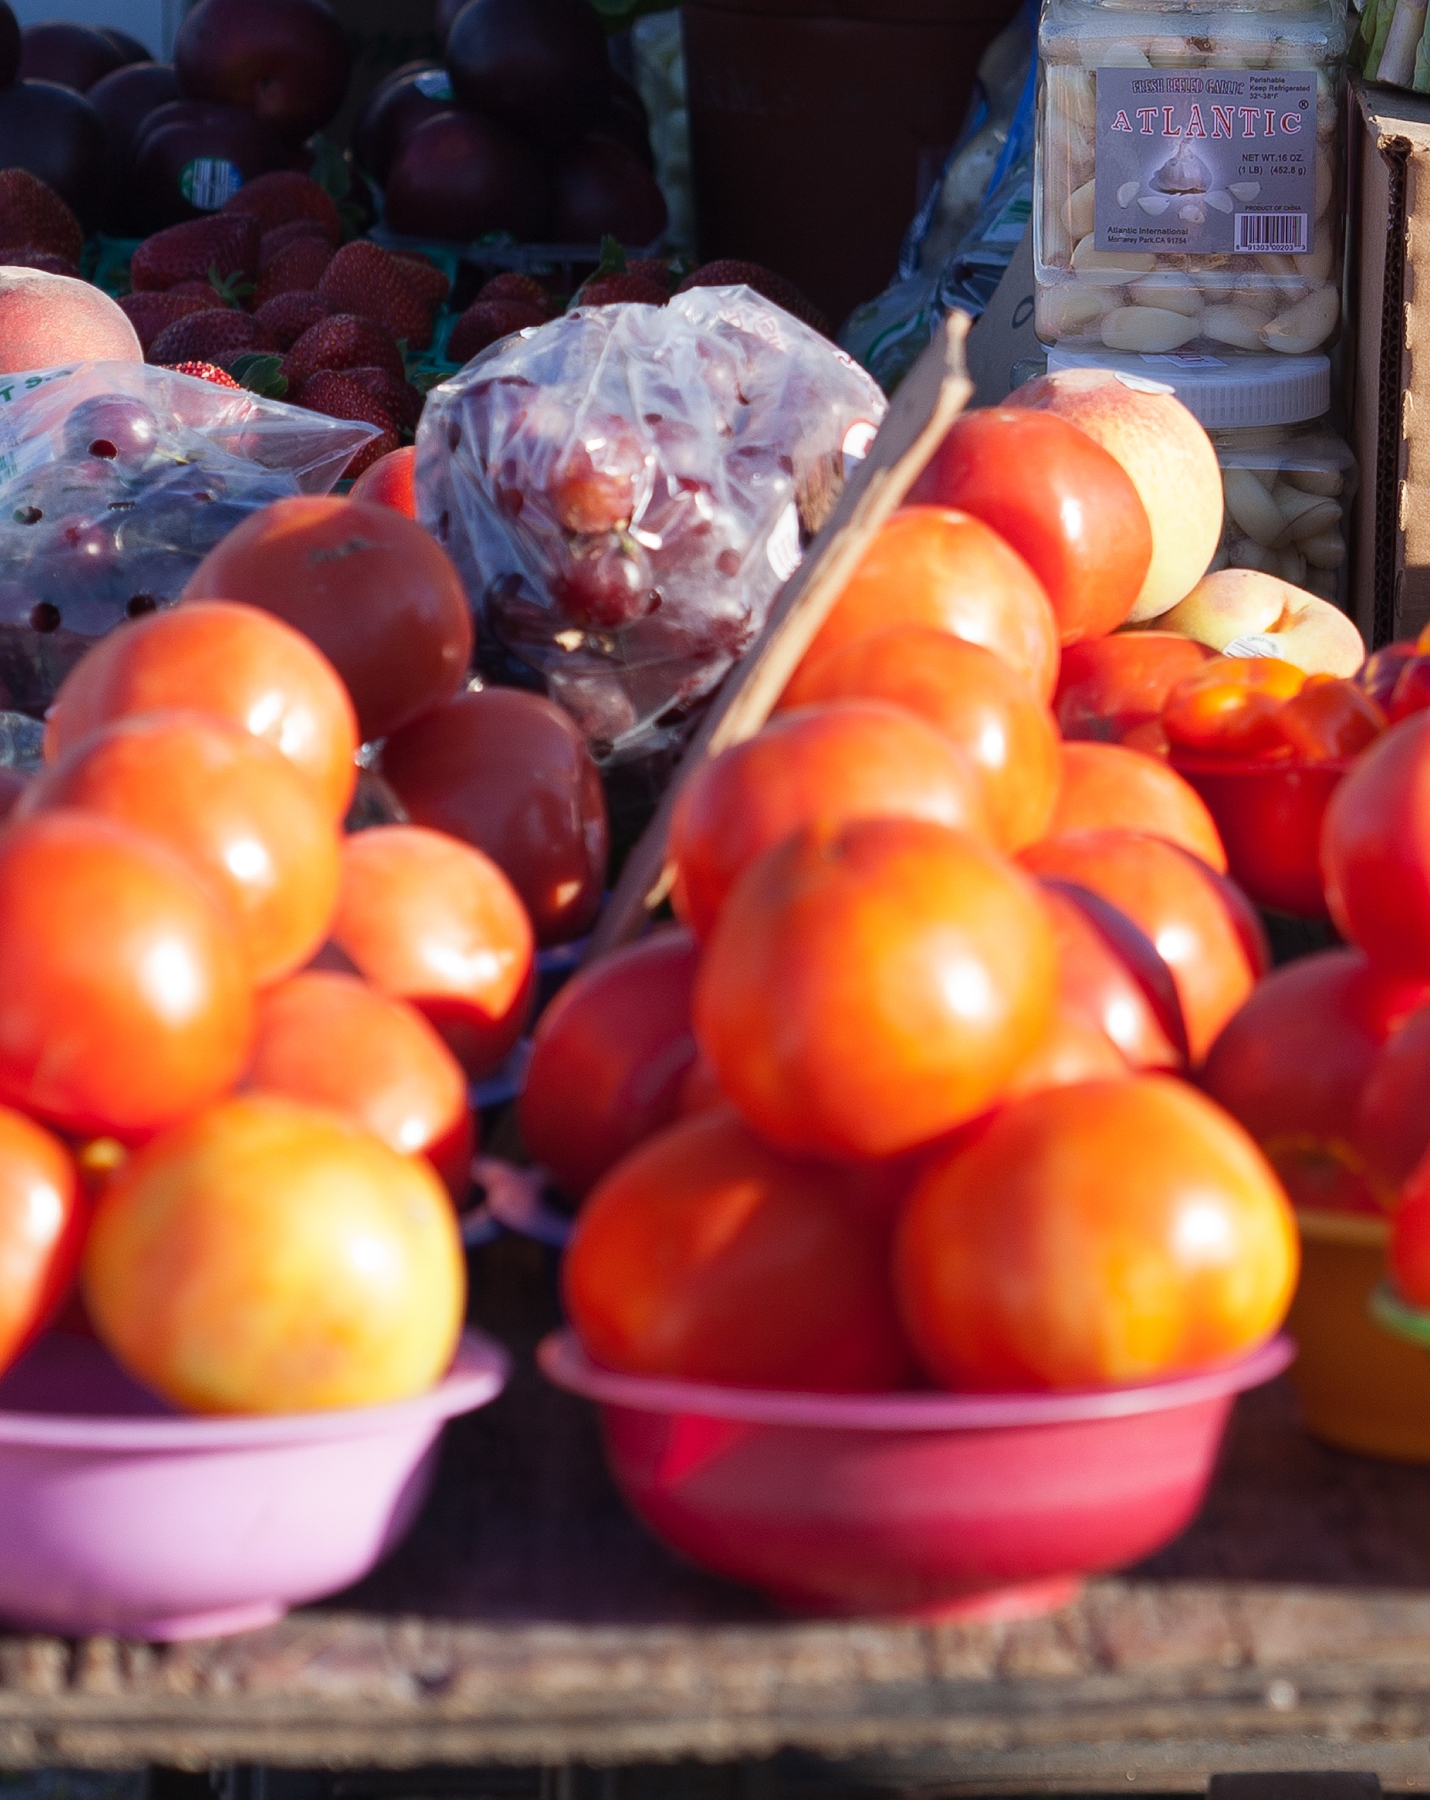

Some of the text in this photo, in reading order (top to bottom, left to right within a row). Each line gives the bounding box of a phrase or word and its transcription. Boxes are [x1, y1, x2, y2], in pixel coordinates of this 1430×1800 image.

[1249, 76, 1286, 84] Perishable
[1132, 77, 1245, 95] FRESH PEELED GARLIC
[1249, 85, 1311, 93] Keep Refrigerated
[1111, 104, 1302, 138] ATLANTIC
[1241, 153, 1259, 162] NET
[1248, 165, 1263, 175] LB)
[1244, 204, 1273, 212] PRODUCT
[1273, 204, 1283, 212] OF
[1107, 226, 1189, 236] Atlantic International
